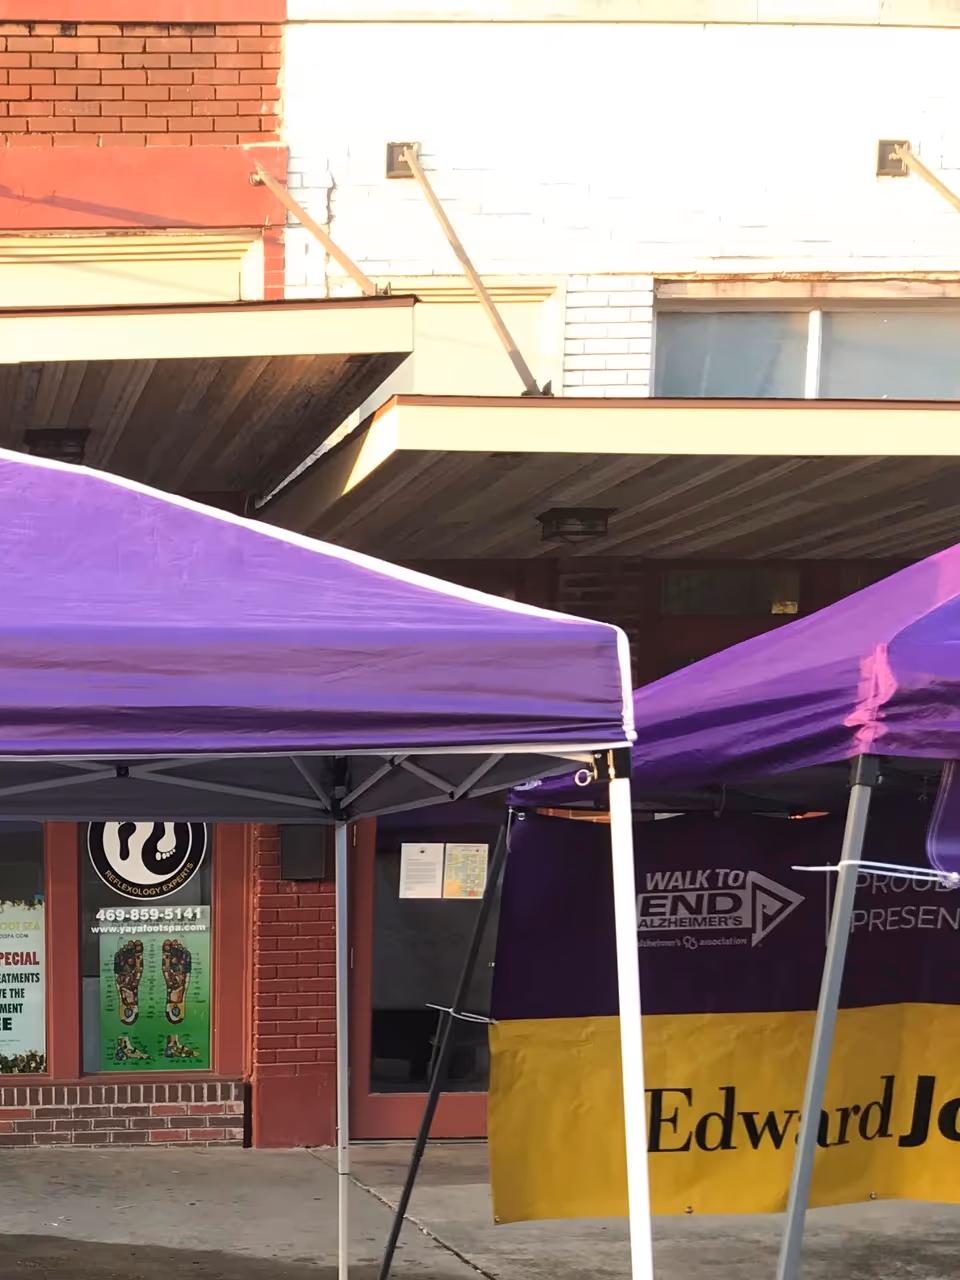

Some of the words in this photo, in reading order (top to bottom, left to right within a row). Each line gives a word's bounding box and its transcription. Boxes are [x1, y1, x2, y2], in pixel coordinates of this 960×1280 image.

[105, 869, 161, 896] REFLEXOLOGY
[162, 862, 194, 892] EXPERTS
[646, 870, 712, 890] WALK
[715, 868, 745, 887] TO
[640, 892, 743, 917] END
[96, 908, 201, 921] 469-859-5141
[638, 916, 743, 928] ALZHEIMER'S
[90, 924, 206, 934] www.yayafootspa.com
[699, 938, 748, 946] association
[10, 988, 25, 998] THE
